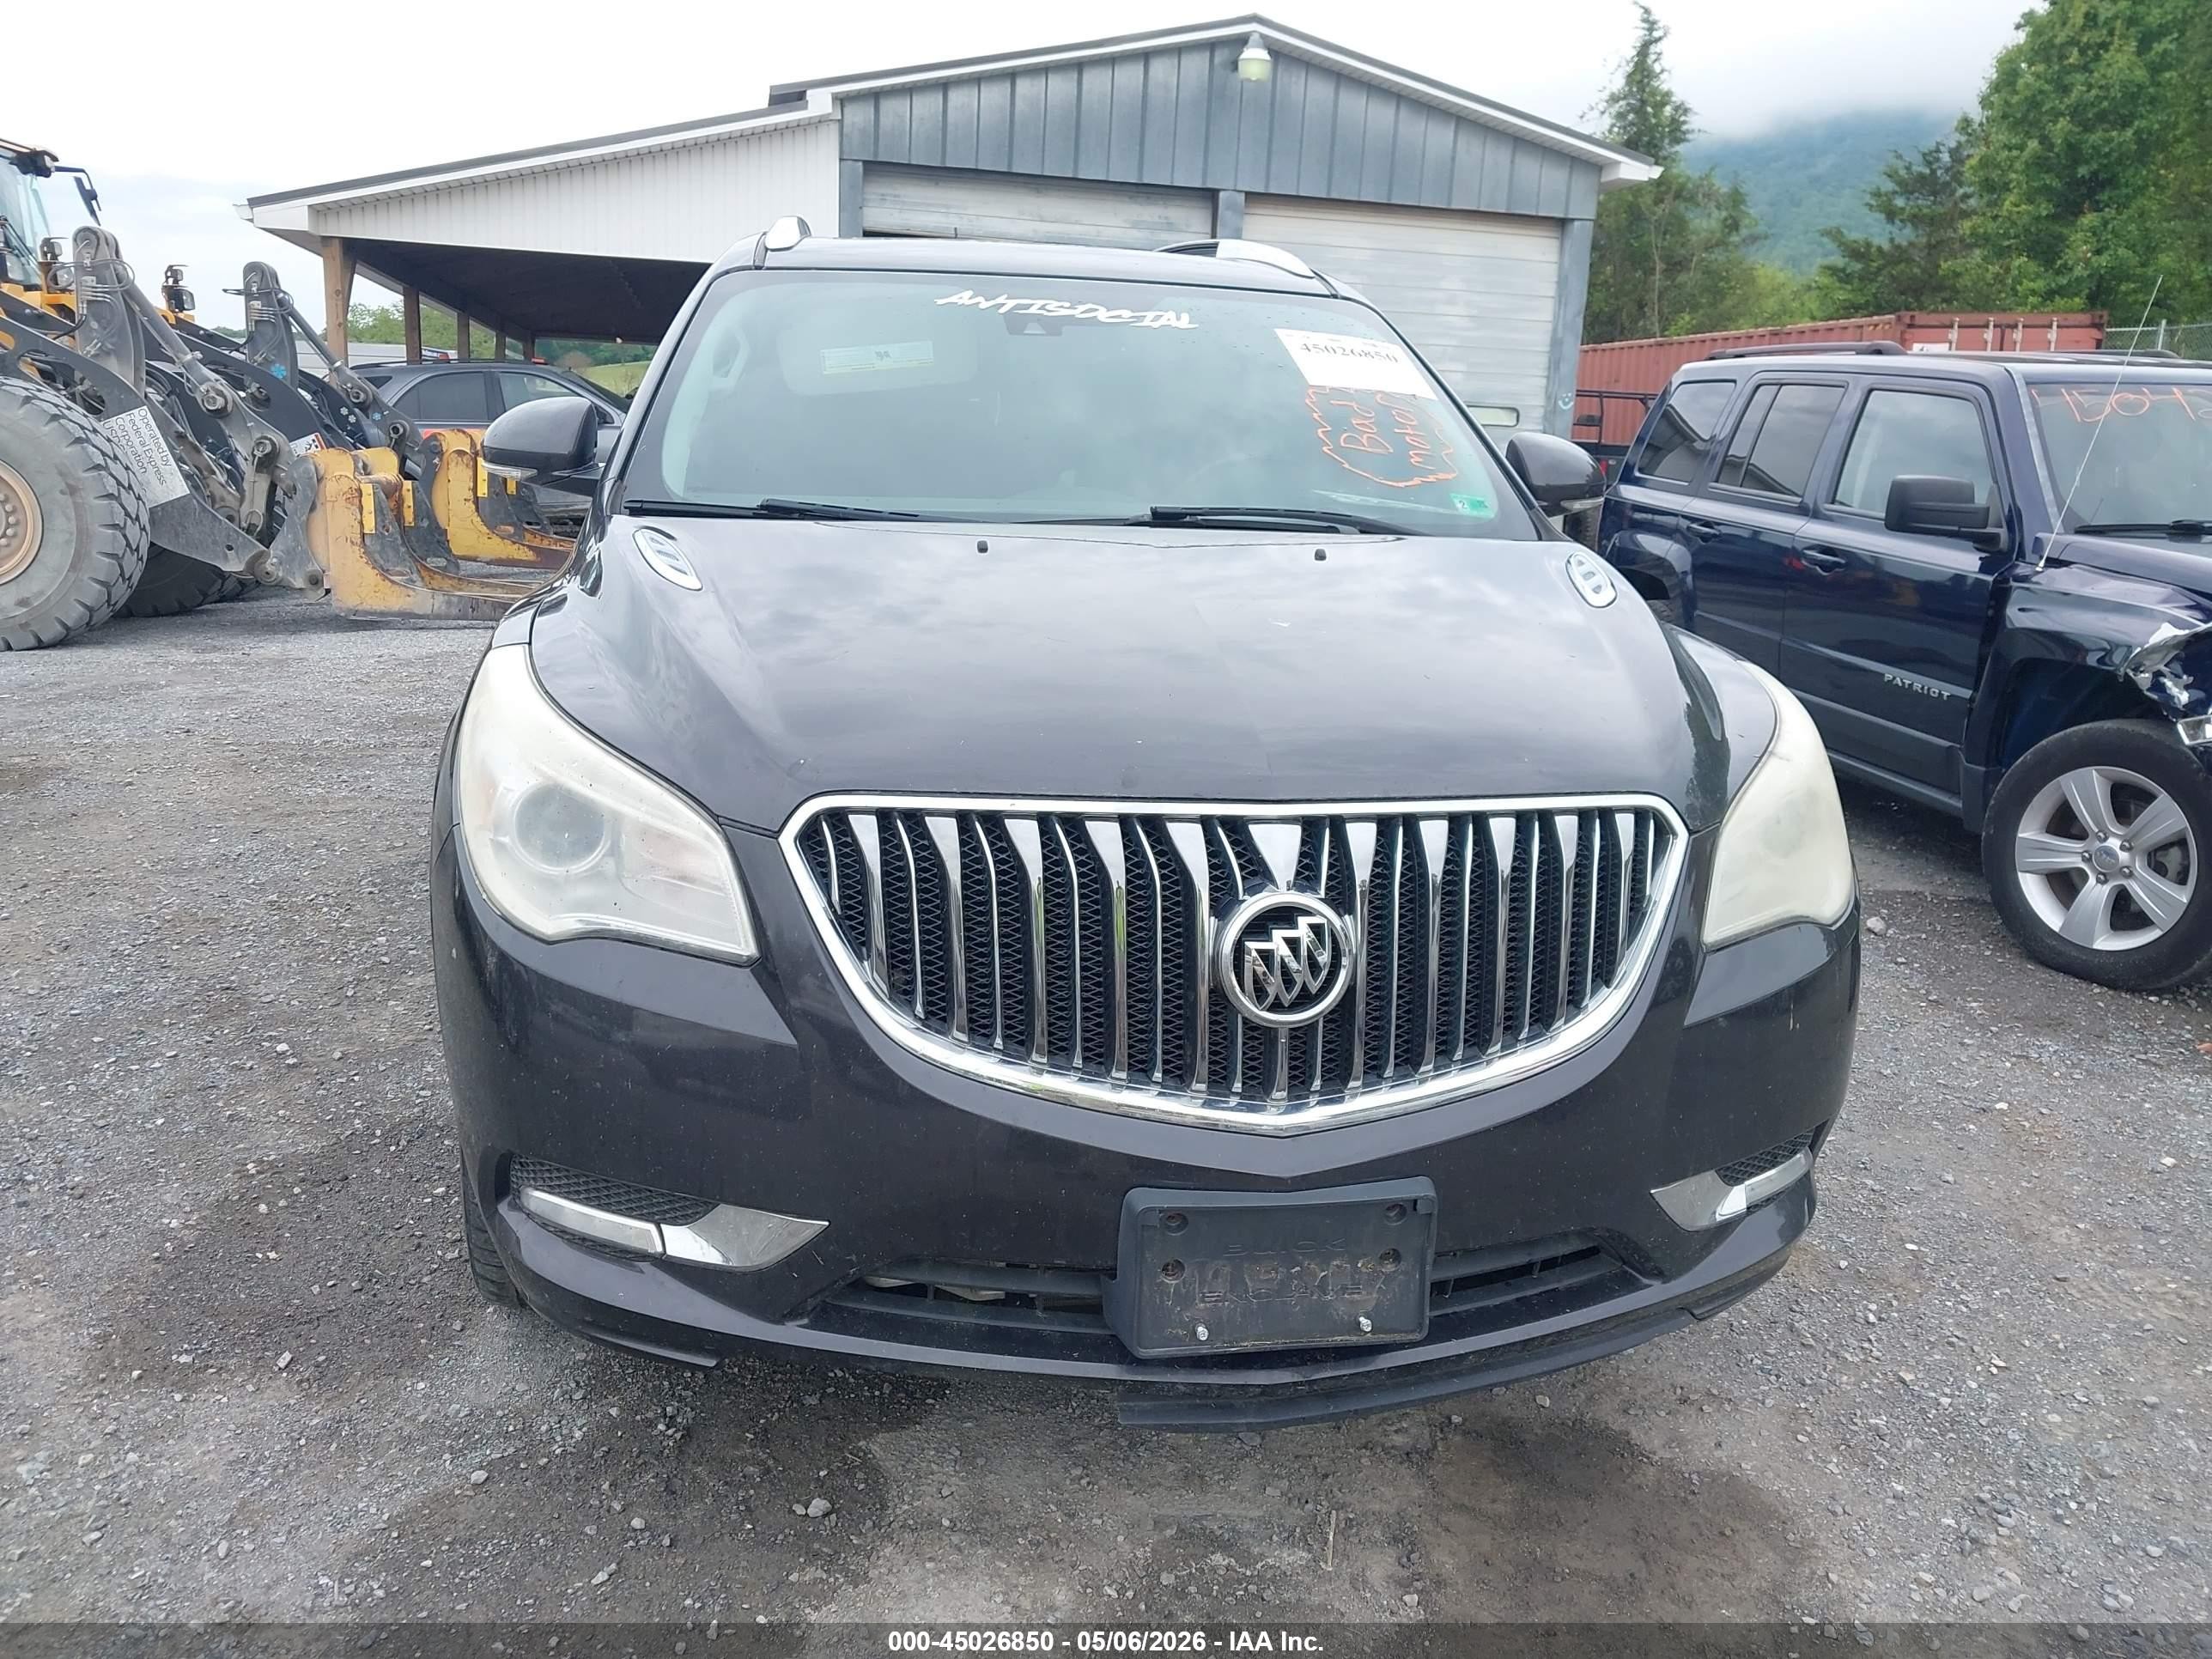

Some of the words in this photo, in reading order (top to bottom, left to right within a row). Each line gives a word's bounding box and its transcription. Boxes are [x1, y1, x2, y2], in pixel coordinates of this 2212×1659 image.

[115, 416, 148, 473] Corporation
[125, 412, 149, 447] Federal
[143, 447, 167, 485] Express
[137, 408, 167, 453] Operated
[161, 453, 172, 466] by
[1330, 399, 1394, 454] Bad
[1884, 673, 1951, 701] PATRIOT
